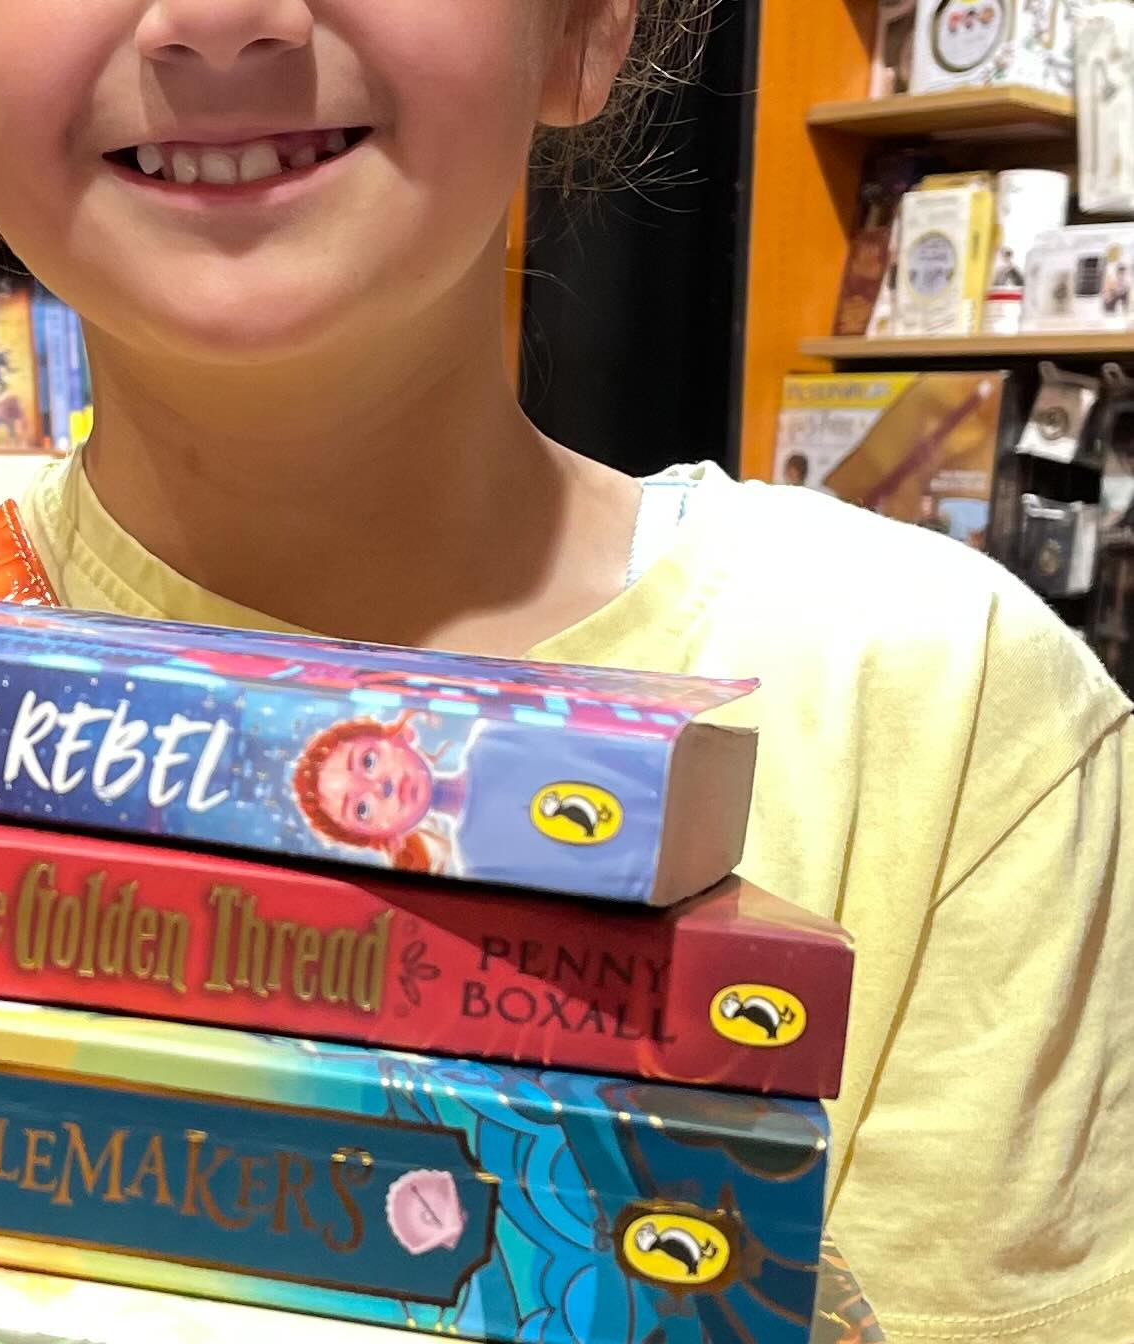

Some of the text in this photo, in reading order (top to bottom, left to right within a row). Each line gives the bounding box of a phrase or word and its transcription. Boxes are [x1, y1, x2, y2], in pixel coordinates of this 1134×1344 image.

[4, 691, 232, 813] REBEL
[16, 862, 189, 994] Golden
[204, 884, 396, 1014] Thread
[480, 934, 674, 995] PENNY
[461, 981, 676, 1046] BOXALL
